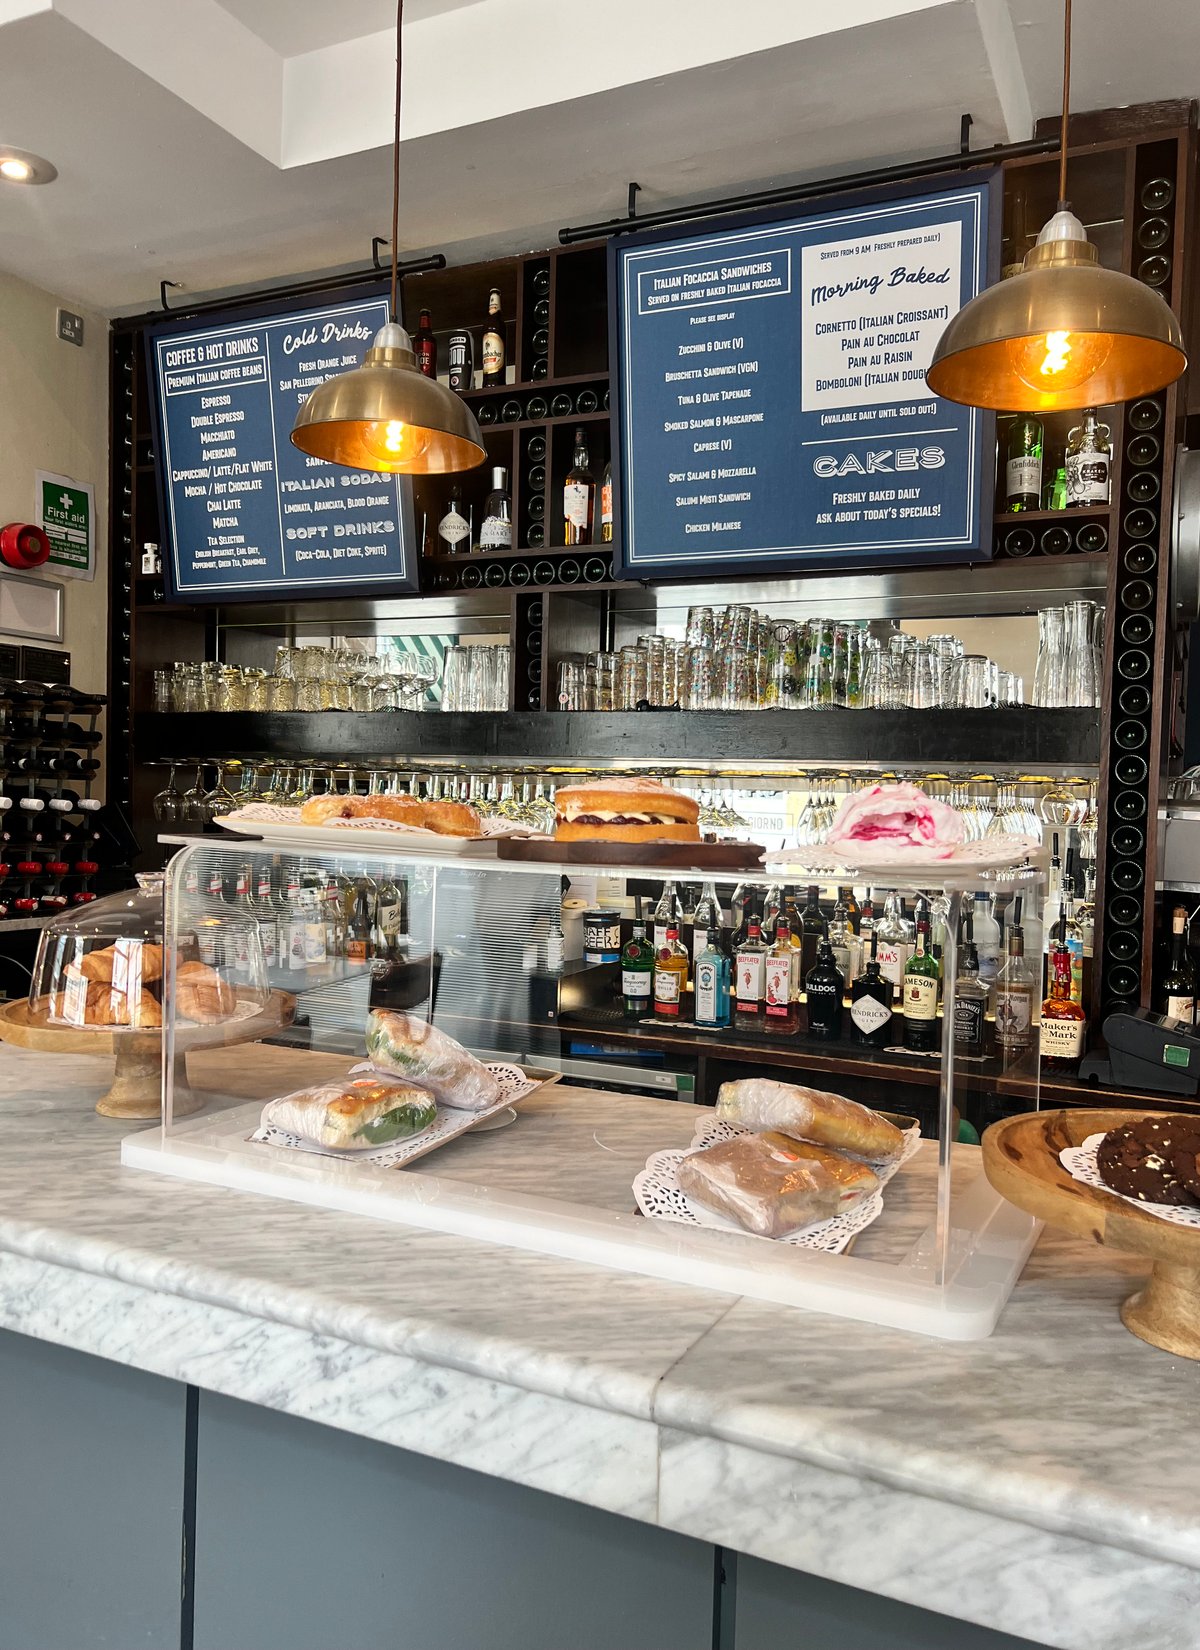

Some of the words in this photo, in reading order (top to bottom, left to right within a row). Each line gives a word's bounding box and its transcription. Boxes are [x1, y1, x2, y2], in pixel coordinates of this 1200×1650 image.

[821, 251, 838, 260] SERVED
[861, 245, 870, 253] AM
[874, 242, 895, 251] FRESHLY
[897, 237, 922, 247] PREPARED
[924, 233, 940, 243] DAILY)
[654, 276, 681, 290] ITALIAN
[684, 271, 718, 286] FOCACCIA
[721, 262, 772, 280] SANDWICHES
[648, 295, 669, 306] SERVED
[671, 294, 679, 302] ON
[681, 291, 704, 300] FRESHLY
[707, 288, 725, 296] BAKED
[728, 282, 750, 294] ITALIAN
[752, 278, 781, 290] FOCACCIA
[811, 275, 884, 306] Morning
[887, 266, 950, 287] Baked
[690, 317, 706, 325] PLEASE
[717, 312, 735, 321] DISPLAY
[816, 319, 856, 335] CORNETTO
[859, 315, 894, 331] (ITALIAN
[897, 305, 948, 324] CROISSANT)
[283, 328, 318, 354] Cold
[321, 321, 372, 343] Drinks
[678, 344, 705, 355] ZUCCHINI
[707, 342, 712, 352] &
[714, 340, 731, 351] OLIVE
[733, 337, 743, 349] (V)
[842, 338, 860, 350] PAIN
[864, 337, 874, 346] AU
[877, 331, 920, 346] CHOCOLAT
[166, 348, 196, 366] COFFEE
[198, 346, 204, 361] &
[206, 343, 223, 360] HOT
[226, 337, 258, 356] DRINKS
[848, 356, 867, 369] PAIN
[870, 354, 881, 365] AU
[884, 351, 912, 364] RAISIN
[299, 362, 316, 372] FRESH
[318, 358, 339, 369] ORANGE
[341, 355, 357, 366] JUICE
[665, 370, 702, 382] BRUSCHETTA
[704, 365, 736, 377] SANDWICH
[738, 361, 758, 374] (VGN)
[168, 375, 195, 389] PREMIUM
[196, 371, 219, 384] ITALIAN
[221, 369, 240, 380] COFFEE
[242, 364, 262, 376] BEANS
[280, 380, 291, 390] SAN
[293, 376, 323, 389] PELLEGRINO
[816, 376, 861, 391] BOMBOLONI
[865, 372, 899, 387] (ITALIAN
[201, 395, 231, 409] ESPRESSO
[678, 395, 694, 405] TUNA
[696, 394, 700, 403] &
[702, 392, 719, 403] OLIVE
[721, 389, 751, 400] TAPENADE
[191, 415, 213, 428] DOUBLE
[215, 411, 244, 424] ESPRESSO
[664, 421, 688, 432] SMOKED
[690, 418, 714, 429] SALMON
[716, 417, 720, 426] &
[723, 413, 764, 426] MASCARPONE
[821, 413, 857, 426] (AVAILABLE
[859, 411, 876, 420] DAILY
[879, 409, 897, 418] UNTIL
[900, 406, 916, 415] SOLD
[918, 403, 936, 414] OUT!)
[200, 430, 235, 444] MACCHIATO
[694, 442, 719, 452] CAPRESE
[721, 439, 731, 451] (V)
[202, 447, 236, 461] AMERICANO
[813, 446, 945, 478] CAKES
[251, 461, 272, 472] WHITE
[669, 473, 685, 483] SPICY
[687, 471, 709, 481] SALAMI
[711, 470, 716, 479] &
[718, 467, 756, 478] MOZZARELLA
[185, 485, 206, 497] MOCHA
[215, 483, 227, 494] HOT
[229, 480, 262, 493] CHOCOLATE
[281, 477, 334, 492] ITALIAN
[340, 472, 391, 486] SODAS
[285, 503, 312, 514] LIMONATA,
[314, 501, 346, 511] ARANCIATA,
[348, 498, 365, 508] BLOOD
[367, 496, 389, 506] ORANGE
[676, 497, 698, 506] SALUMI
[700, 495, 717, 504] MISTI
[719, 492, 750, 503] SANDWICH
[833, 492, 866, 505] FRESHLY
[869, 490, 895, 501] BAKED
[898, 488, 920, 499] DAILY
[207, 501, 221, 512] CHAI
[224, 500, 241, 510] LATTE
[816, 514, 832, 523] ASK
[835, 512, 860, 522] ABOUT
[864, 508, 896, 520] TODAY'S
[900, 504, 940, 518] SPECIALS!
[48, 506, 68, 520] First
[72, 513, 85, 524] aid
[213, 517, 238, 528] MATCHA
[286, 526, 328, 539] SOFT
[334, 520, 394, 536] DRINKS
[685, 524, 710, 533] CHICKEN
[712, 521, 741, 532] MILANESE
[208, 537, 218, 546] TEA
[219, 535, 244, 545] SELECTION
[333, 549, 345, 558] DIET
[347, 547, 363, 558] COKE,
[365, 544, 386, 556] SPRITE)
[738, 956, 759, 964] BEEFEATER
[766, 959, 788, 967] BEEFEATER
[1040, 1022, 1078, 1031] Maker's
[1049, 1030, 1077, 1039] Mark
